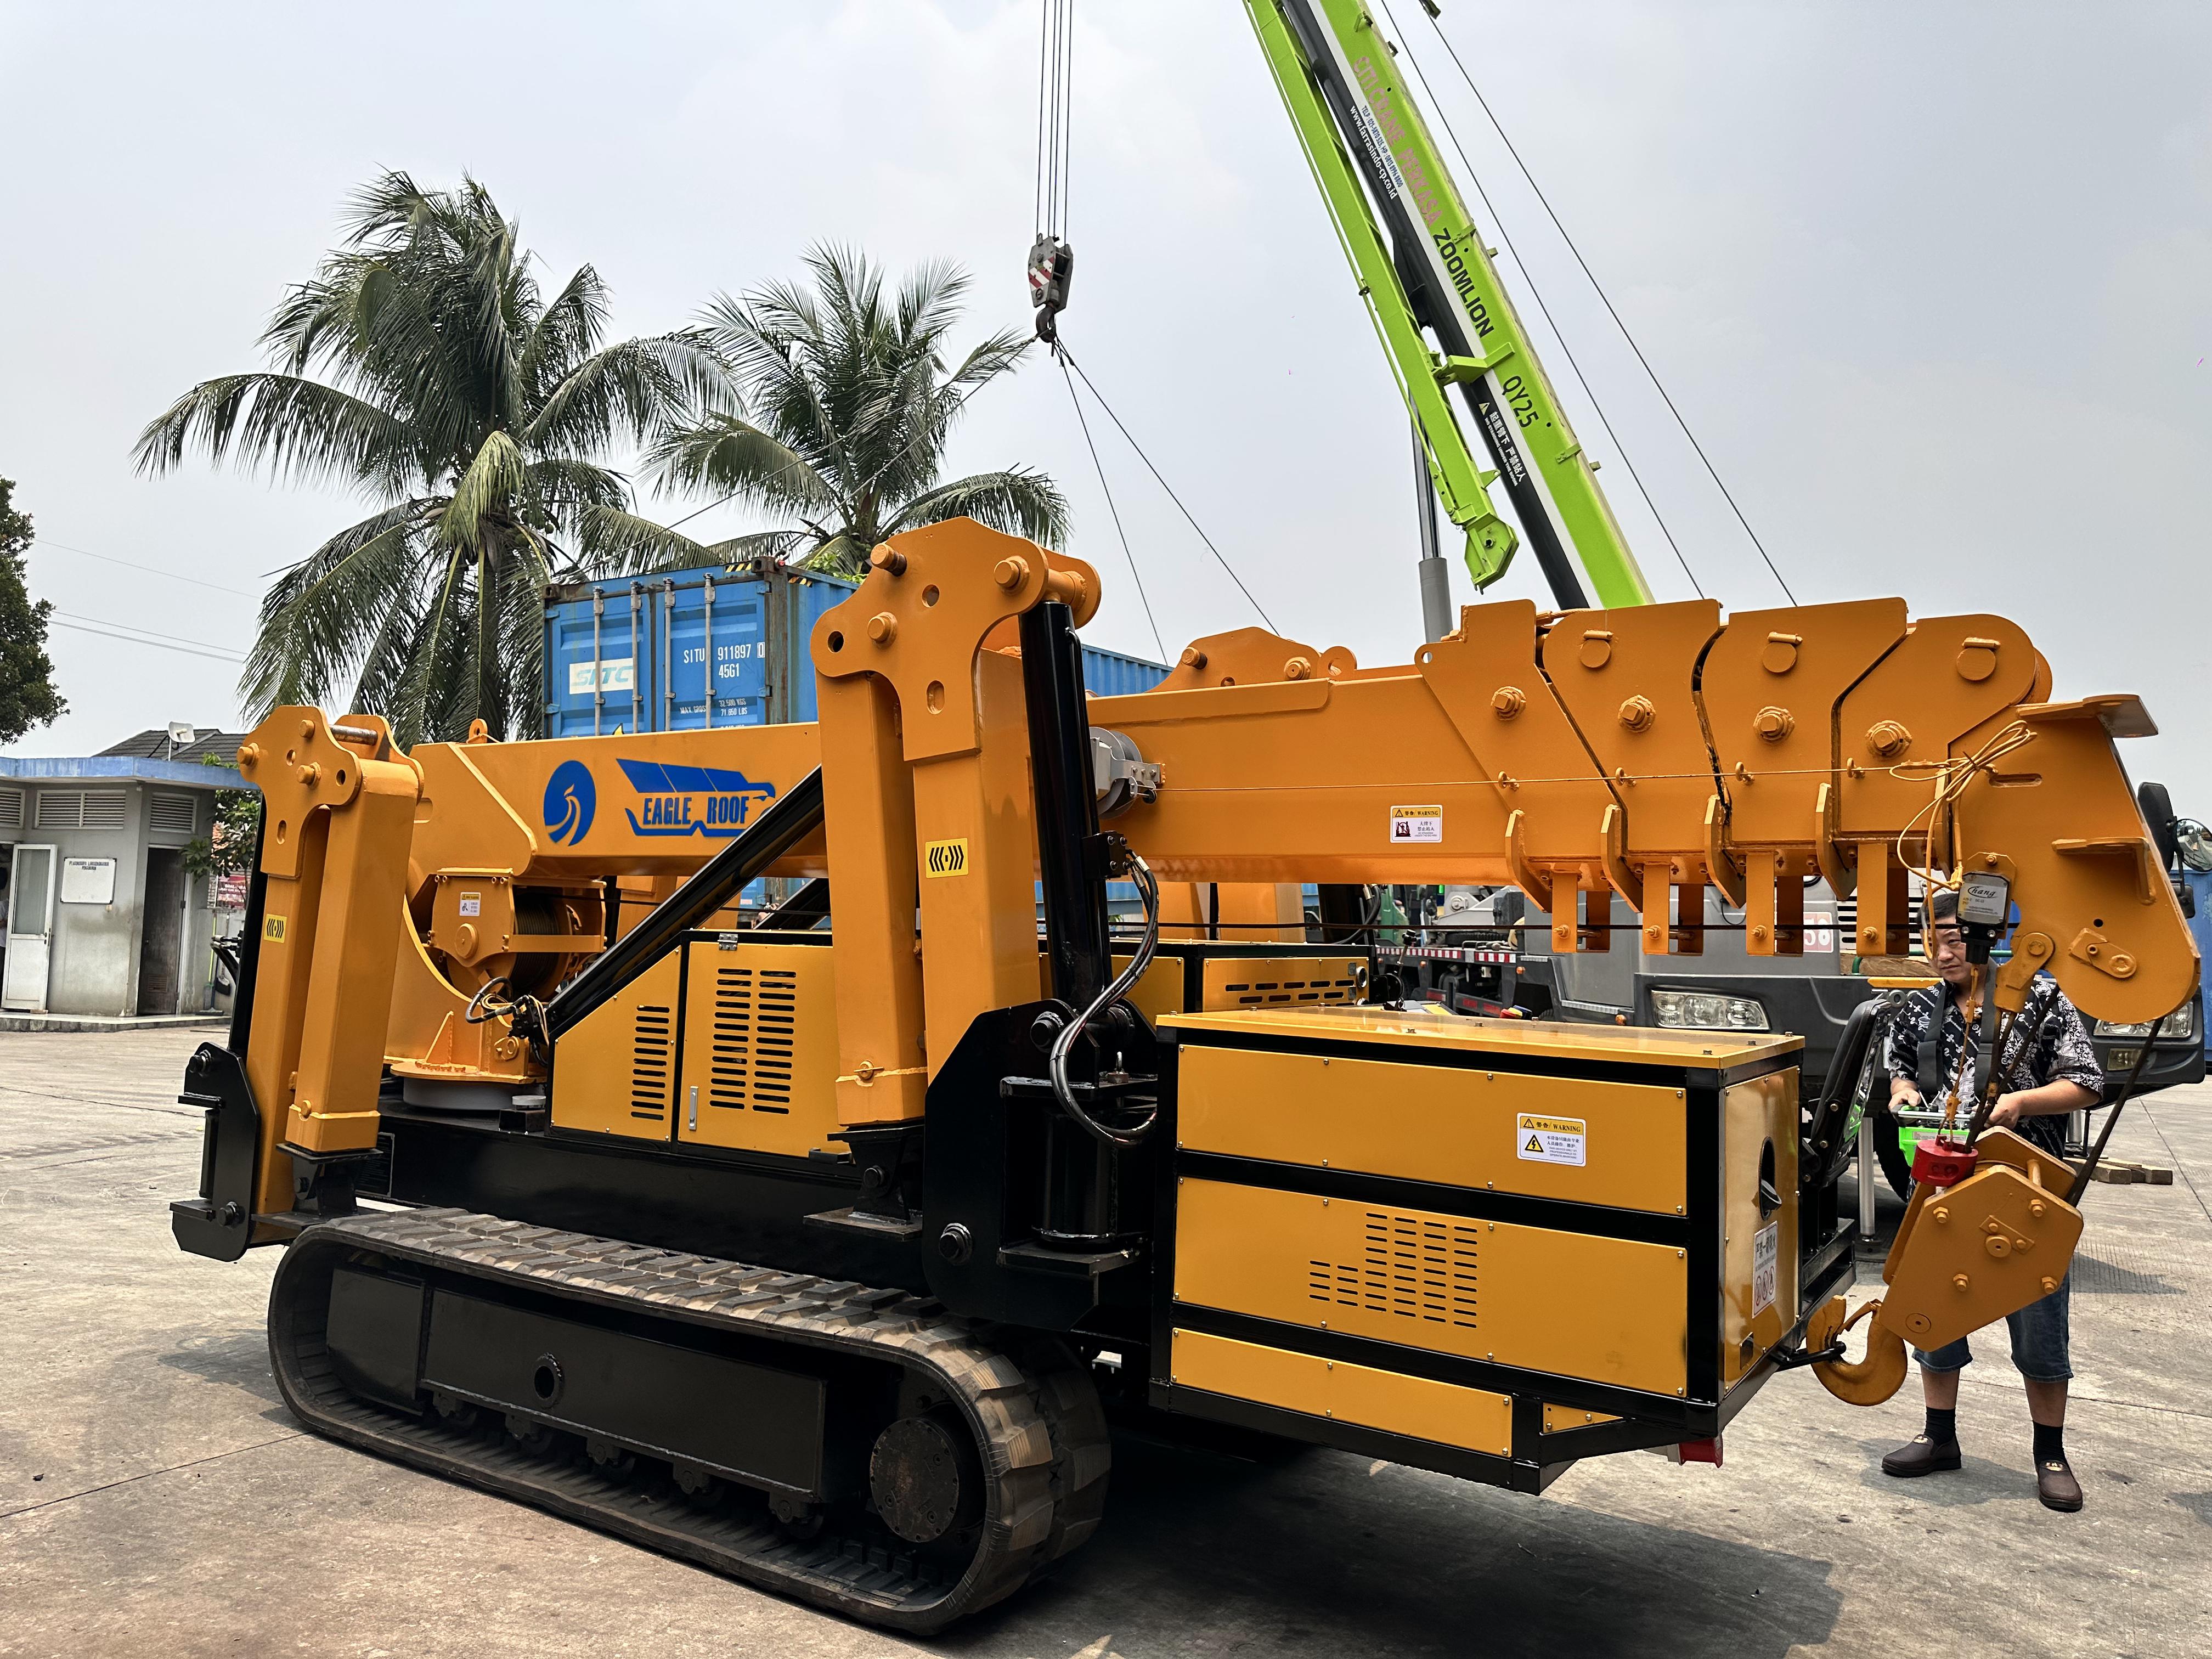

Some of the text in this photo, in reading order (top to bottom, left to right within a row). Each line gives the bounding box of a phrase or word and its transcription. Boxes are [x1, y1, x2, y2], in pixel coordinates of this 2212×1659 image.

[1350, 105, 1398, 200] www.farrasindo-cp.co.id
[1353, 57, 1442, 227] CITI CRANE PERKASA
[1432, 227, 1494, 338] ZOOMLION
[1502, 375, 1539, 428] QY25
[1489, 411, 1526, 482] 起重臂下 严禁站人
[684, 647, 706, 663] SITU
[718, 644, 752, 661] 911897
[574, 665, 633, 686] SITC
[719, 663, 740, 679] 45G1
[738, 707, 748, 715] LBS
[643, 796, 749, 825] EAGLE ROOF
[1553, 1124, 1581, 1132] WARNING
